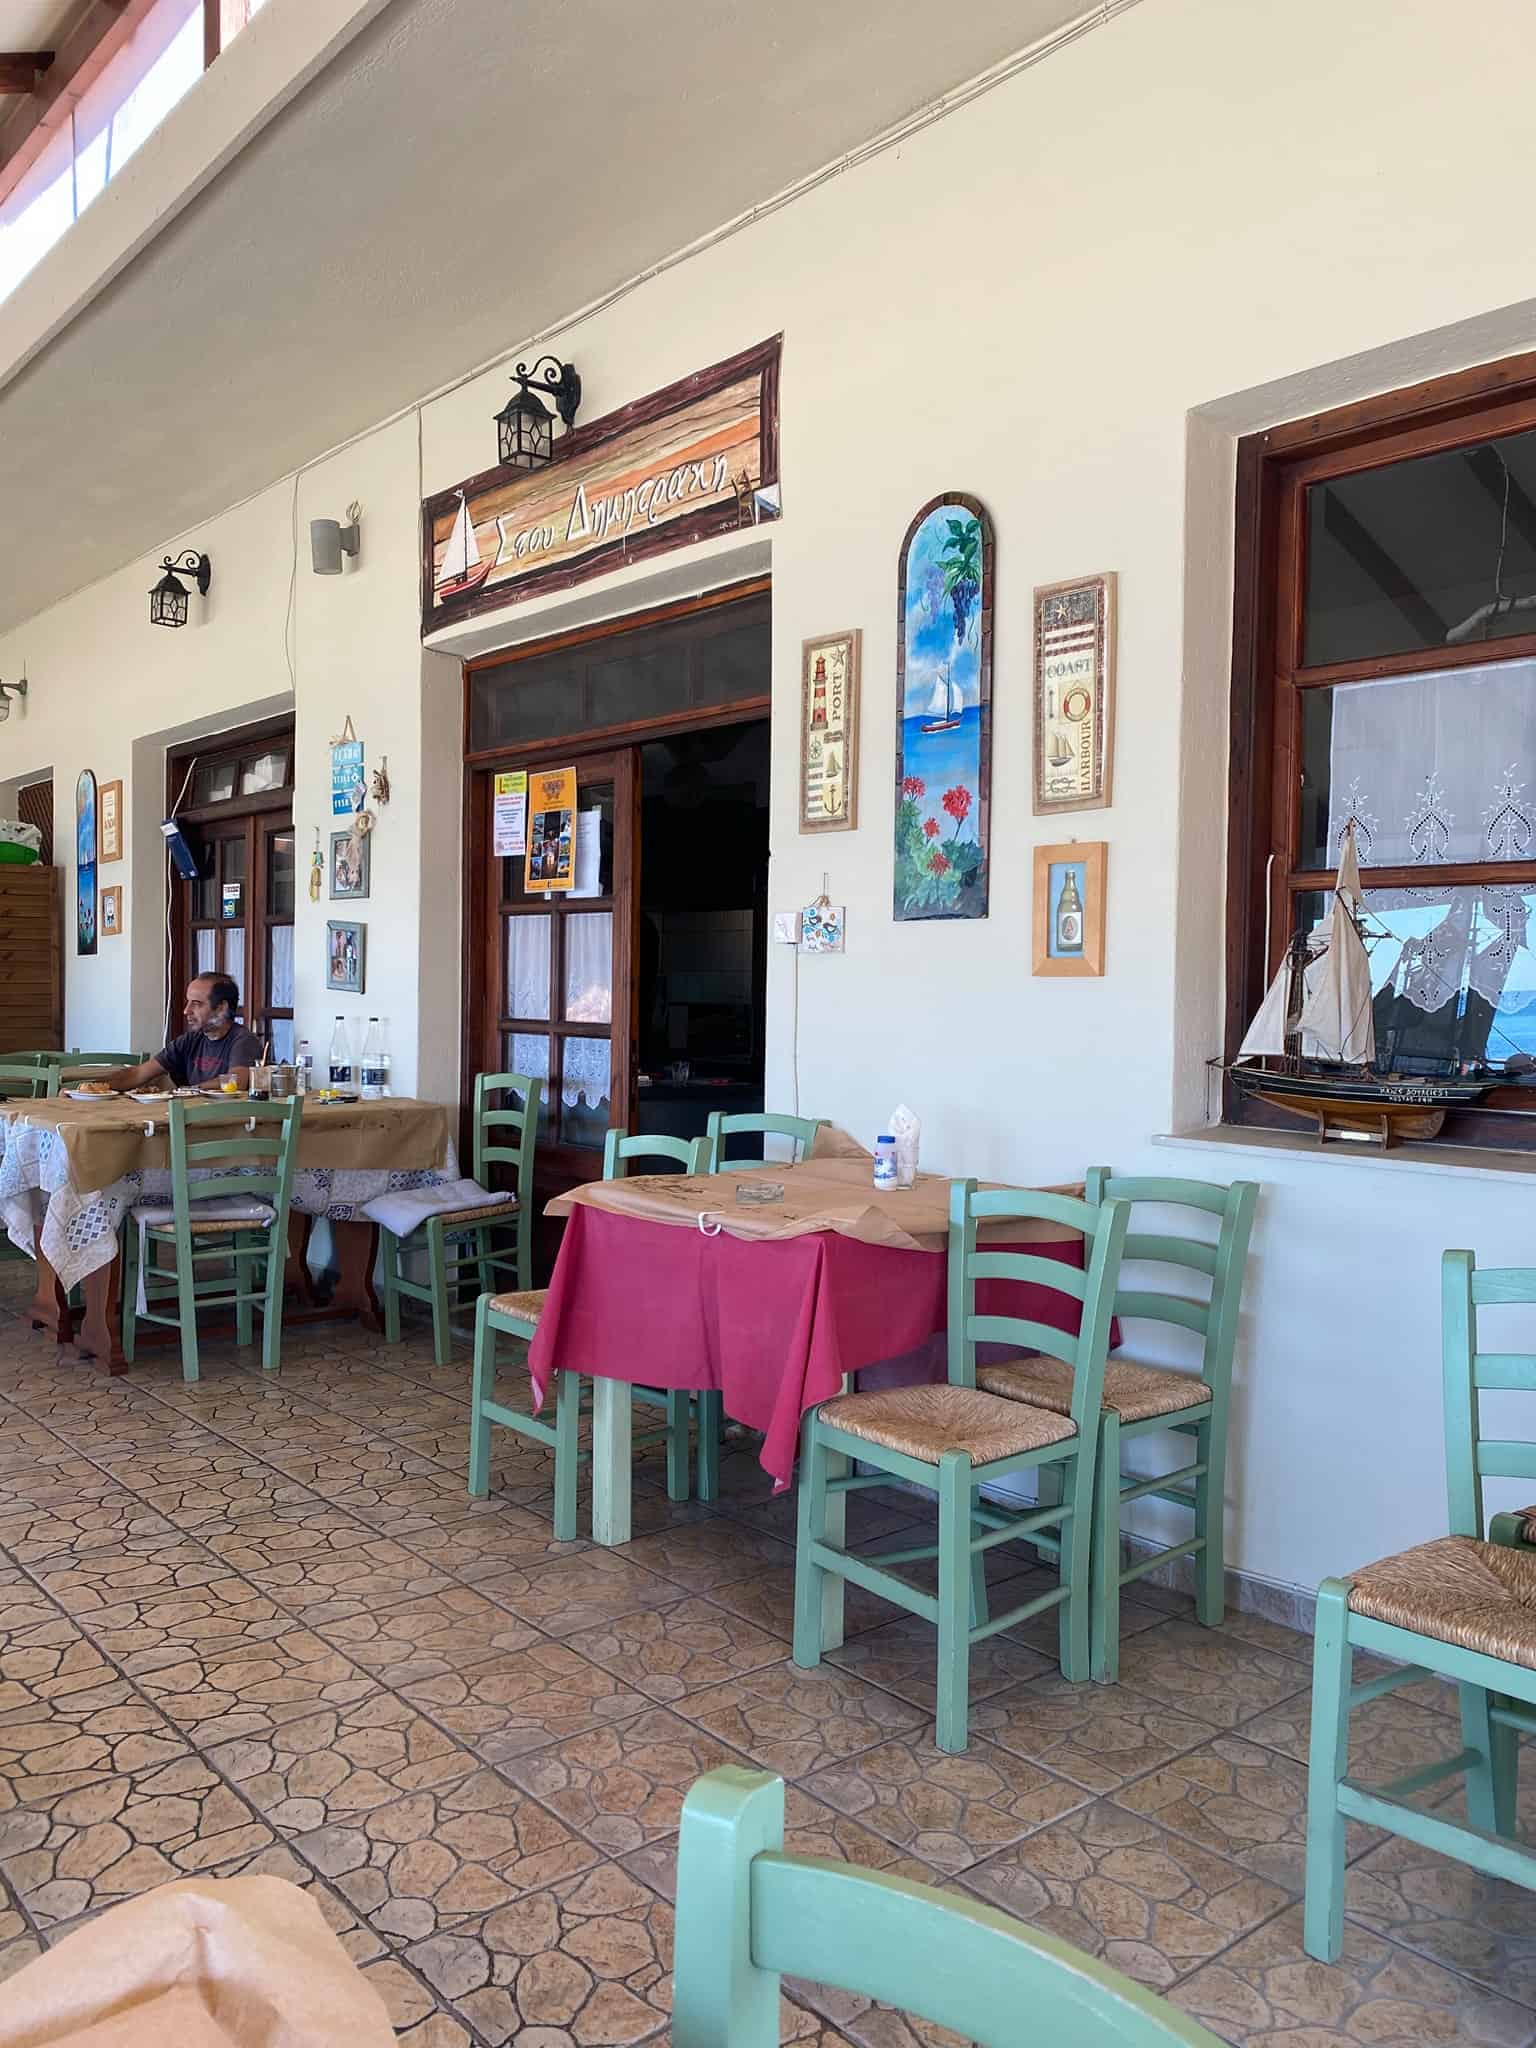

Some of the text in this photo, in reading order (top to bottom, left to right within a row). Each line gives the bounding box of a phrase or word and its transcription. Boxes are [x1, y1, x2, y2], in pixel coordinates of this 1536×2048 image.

[496, 514, 554, 566] Στου
[1047, 658, 1092, 679] COAST
[831, 675, 843, 721] PORT
[1080, 721, 1092, 793] HARBOUR
